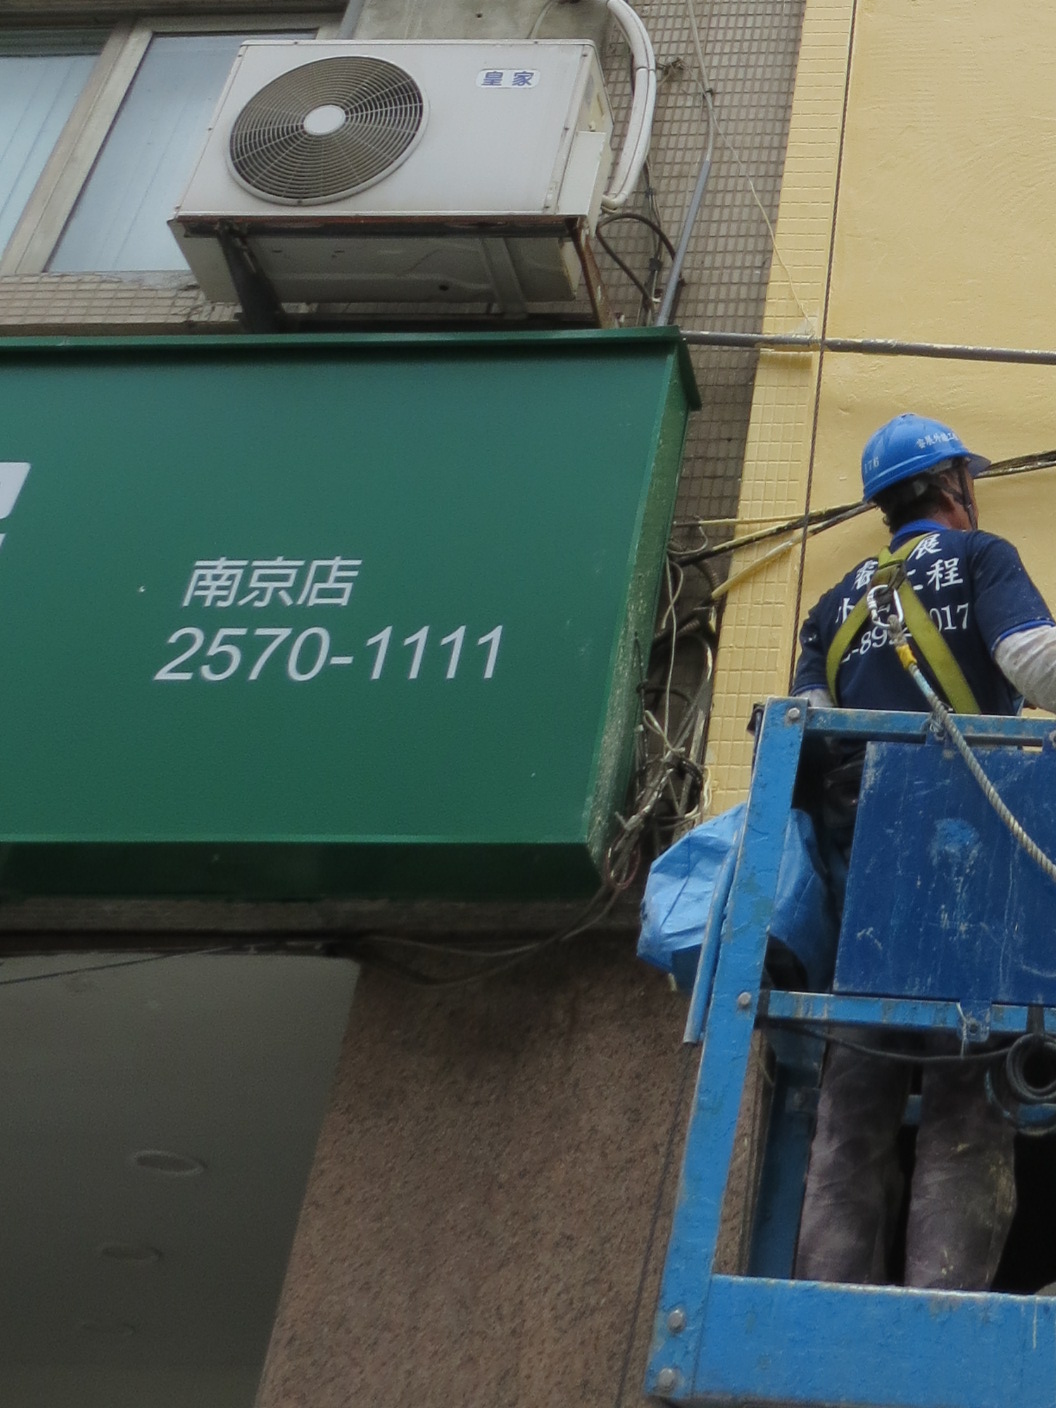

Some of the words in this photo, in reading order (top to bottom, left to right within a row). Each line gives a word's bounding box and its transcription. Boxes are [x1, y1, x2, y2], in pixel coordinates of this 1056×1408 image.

[481, 71, 535, 86] 皇家
[182, 556, 363, 609] 南京店
[153, 625, 504, 682] 2570-1111
